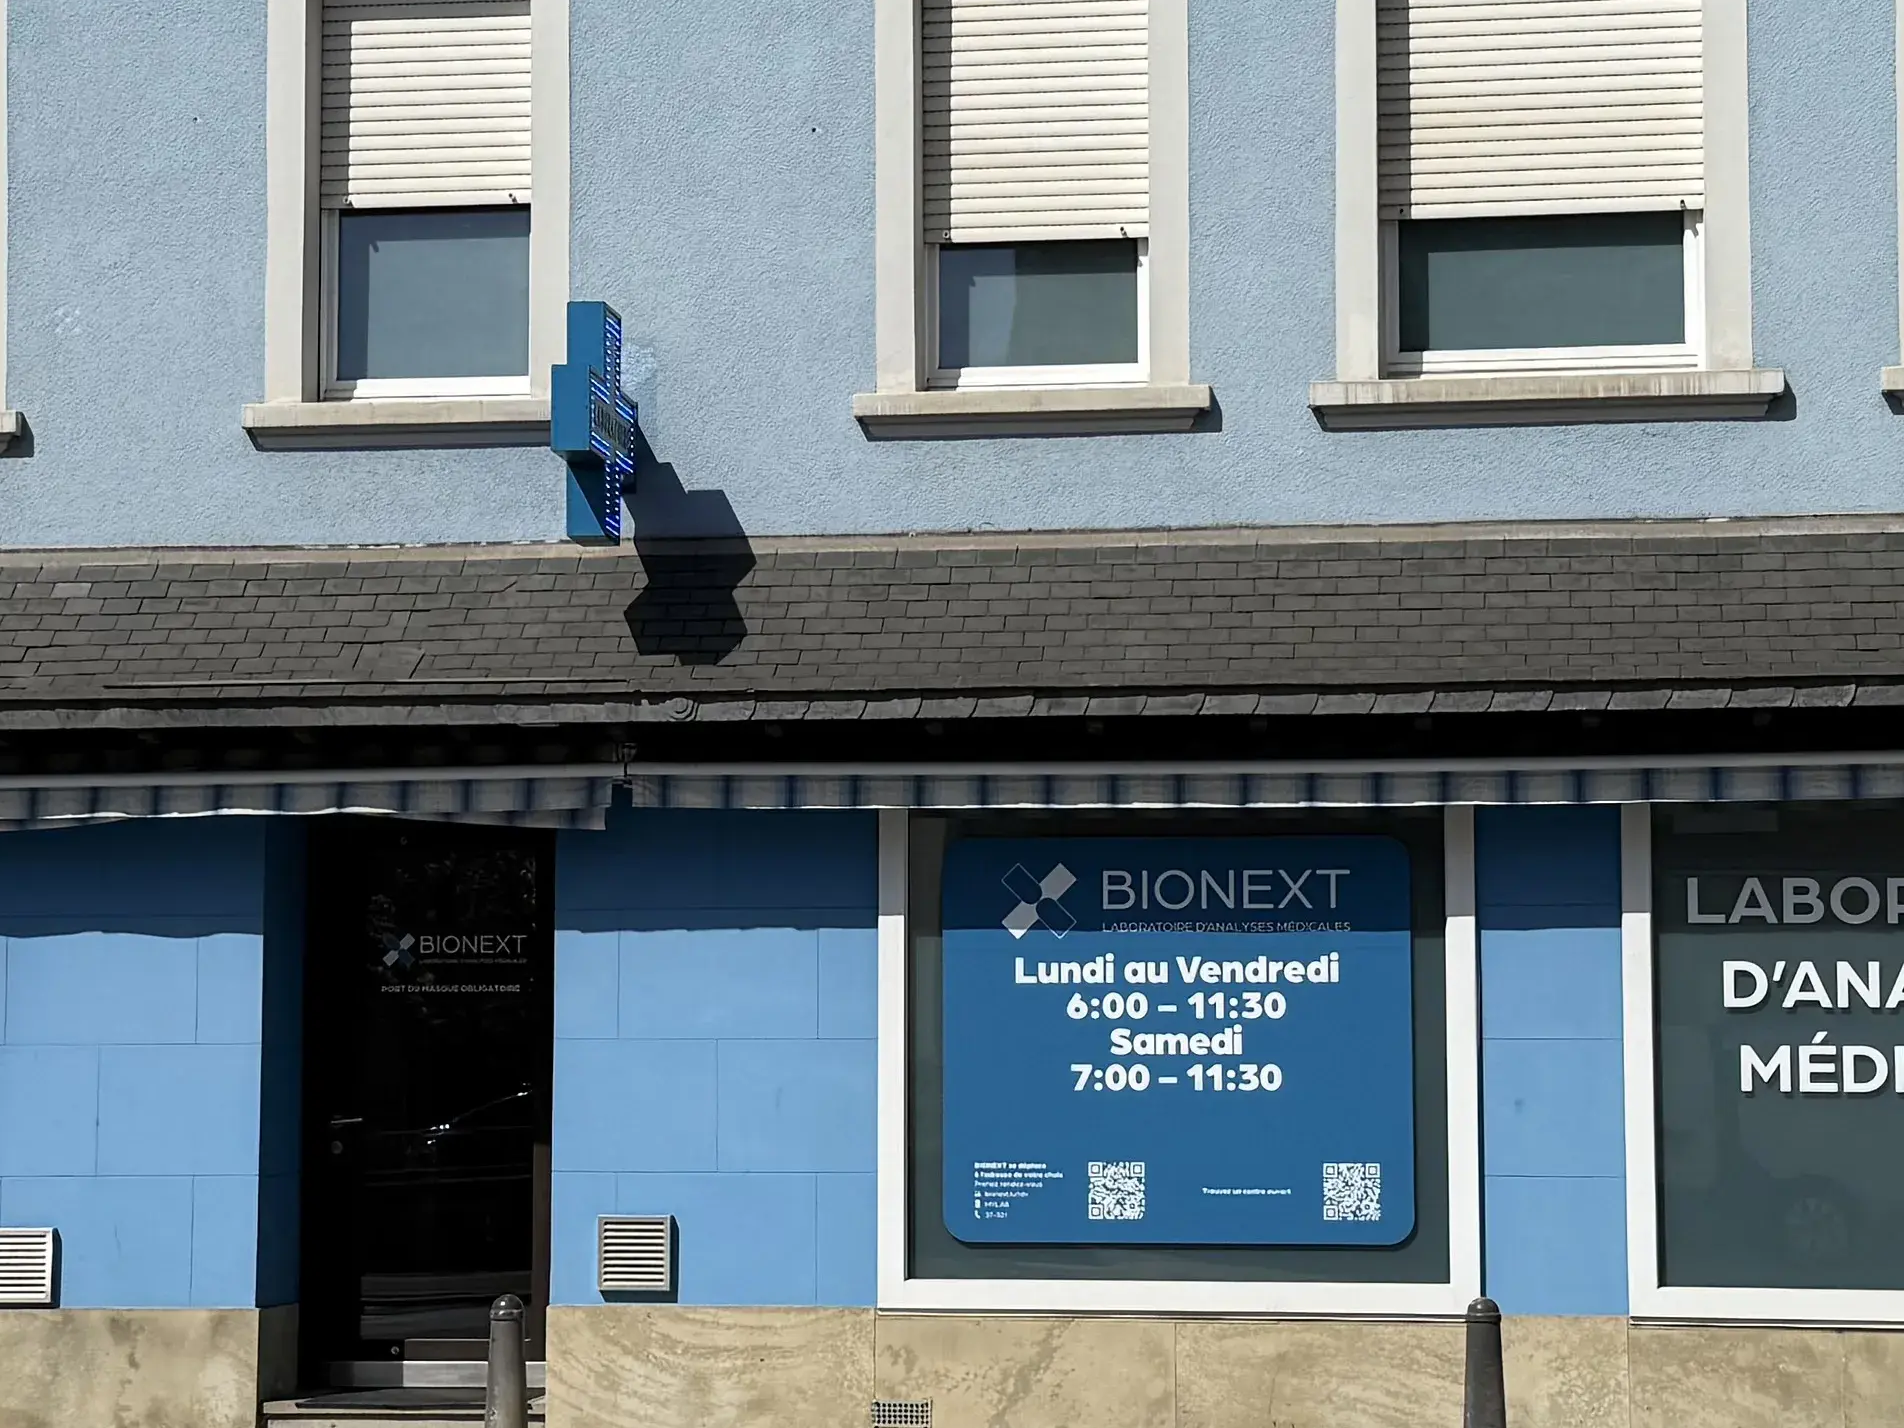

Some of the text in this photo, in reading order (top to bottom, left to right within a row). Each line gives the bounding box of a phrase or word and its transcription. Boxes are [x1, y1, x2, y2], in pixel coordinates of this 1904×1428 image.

[1102, 869, 1351, 910] BIONEXT
[1102, 919, 1351, 933] LABORATOIRE D'ANALYSES MÉDICALES
[419, 934, 528, 954] BIONEXT
[1015, 951, 1339, 984] Lundi au Vendredi
[1066, 991, 1148, 1020] 6:00
[1187, 991, 1286, 1020] 11:30
[1110, 1023, 1243, 1056] Samedi
[1070, 1063, 1150, 1092] 7:00
[1186, 1063, 1283, 1092] 11:30
